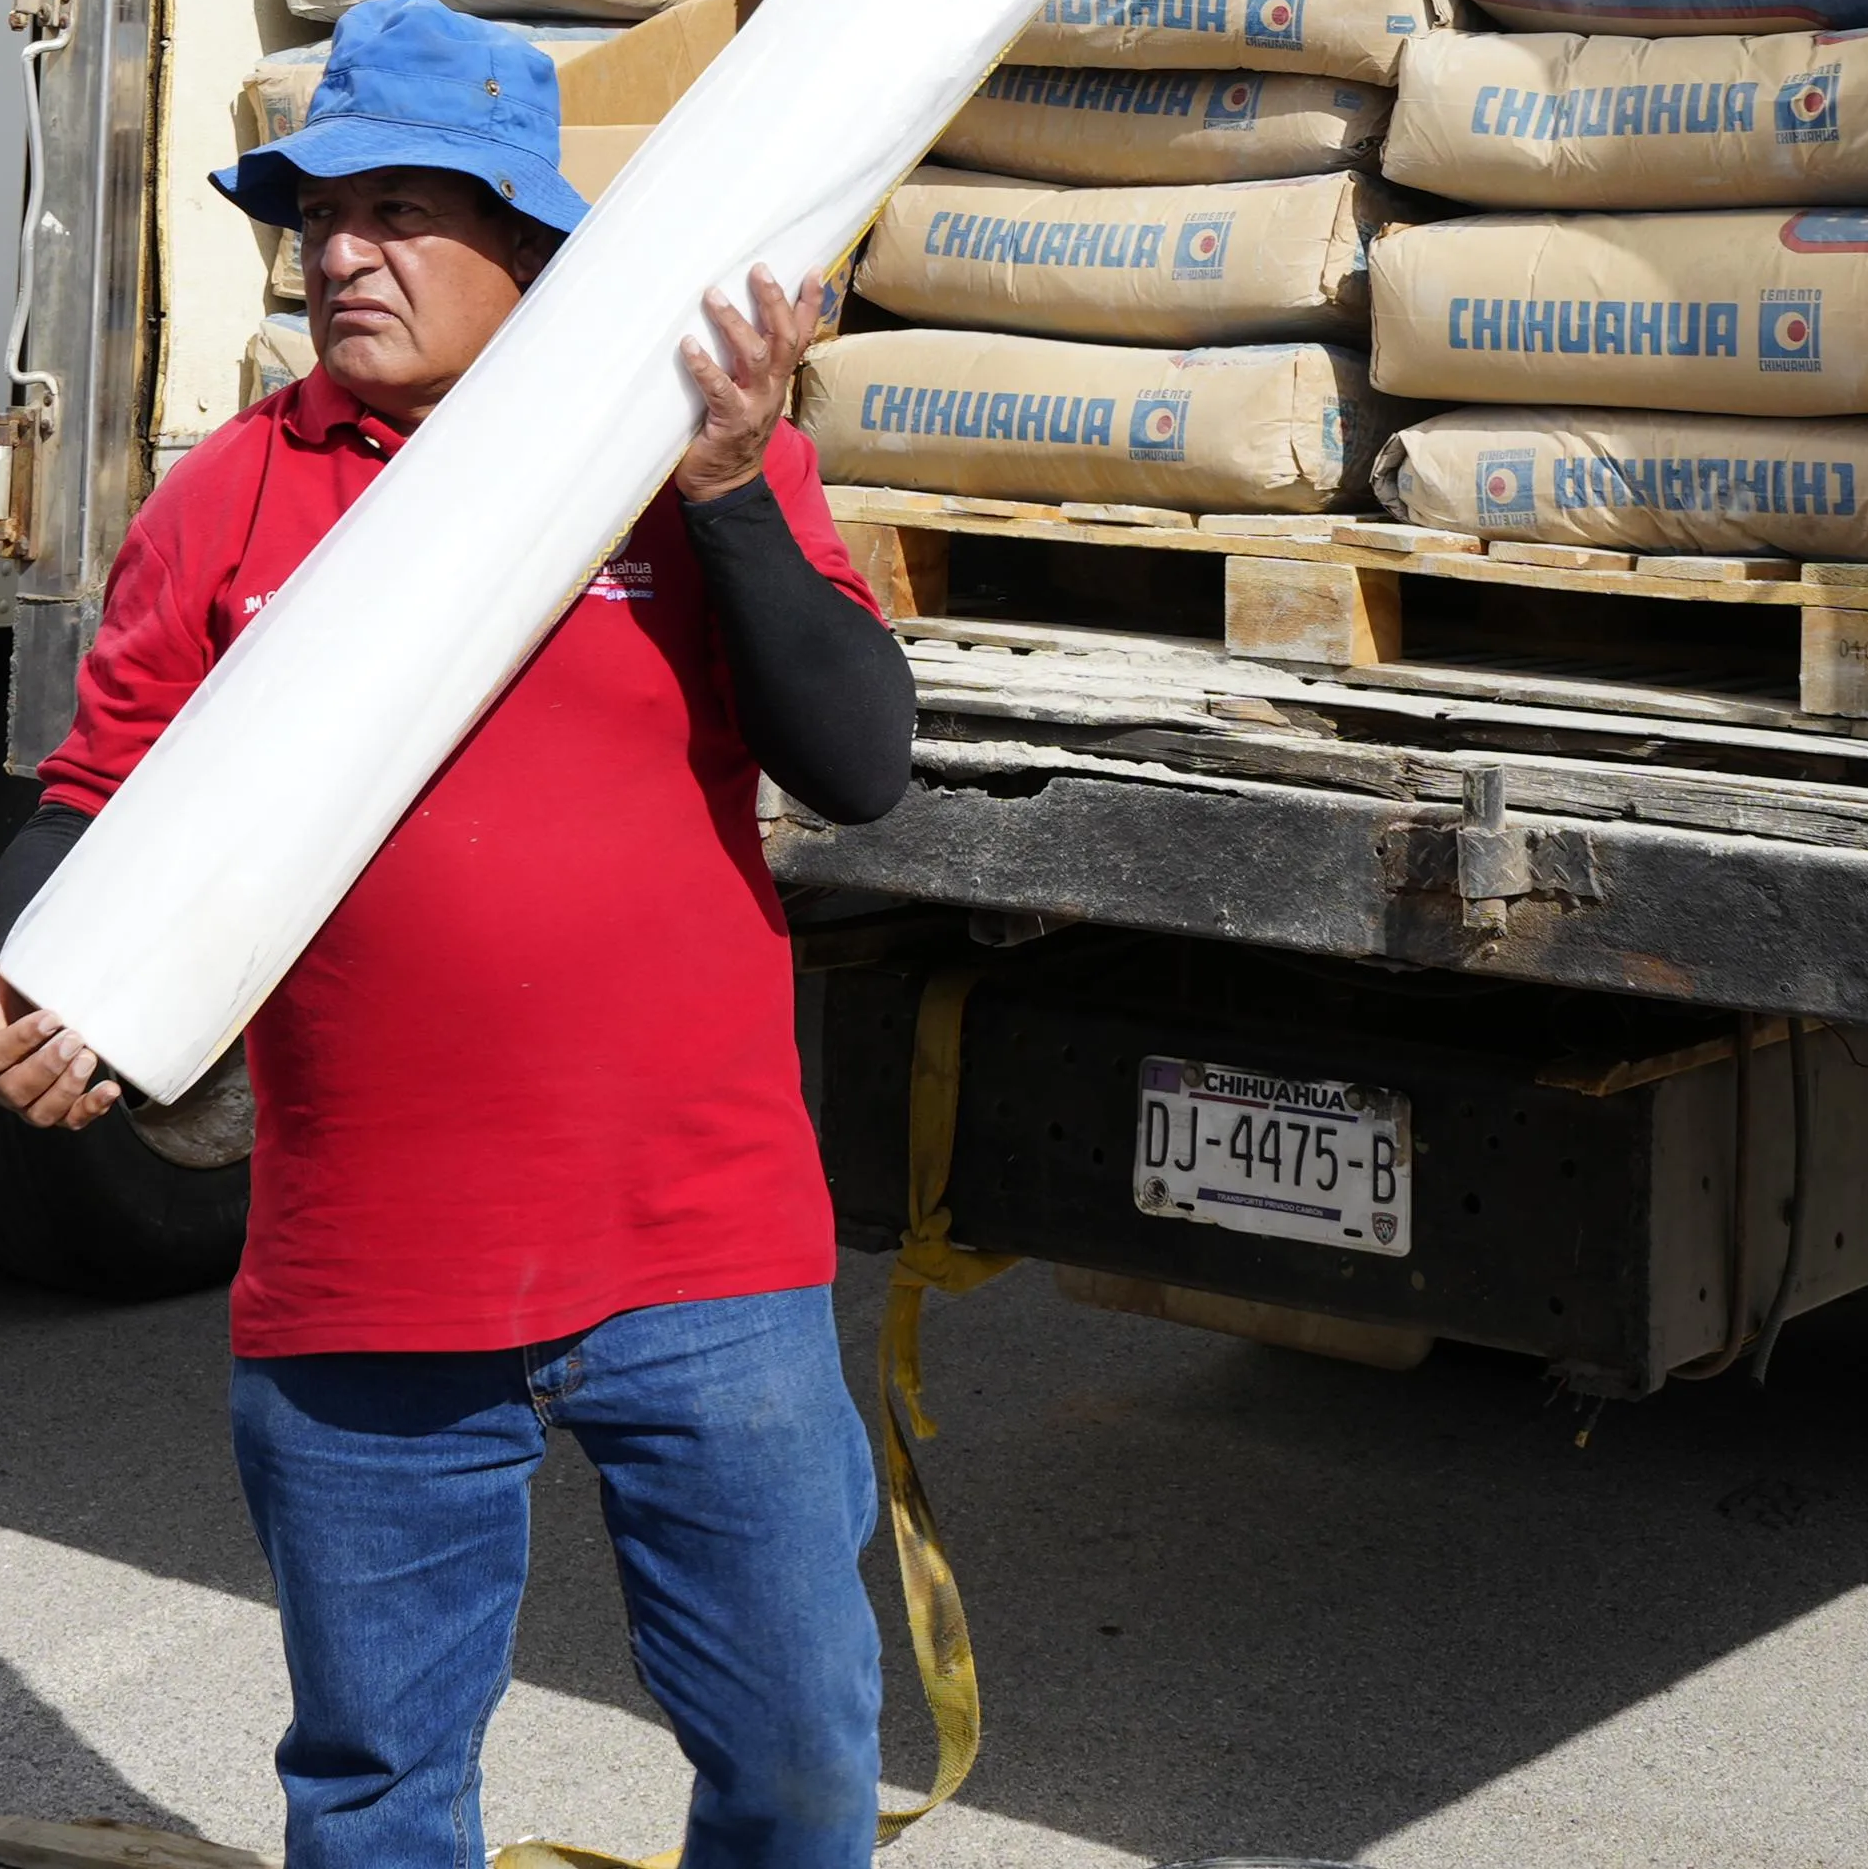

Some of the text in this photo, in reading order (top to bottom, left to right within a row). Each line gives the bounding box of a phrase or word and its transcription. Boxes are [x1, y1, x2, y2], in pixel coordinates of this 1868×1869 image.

[1471, 82, 1758, 140] CHIHUAHUA
[924, 211, 1166, 268] CHIHUAHUA
[1760, 289, 1822, 301] CEMENTO
[1449, 298, 1738, 357] CHIHUAHUA
[1759, 359, 1822, 372] CHIHUAHUA
[861, 384, 1115, 446] CHIHUAHUA
[1554, 457, 1855, 516] CHIHUAHUA
[242, 594, 263, 614] JM
[1203, 1071, 1346, 1112] CHIHUAHUA
[1145, 1100, 1397, 1205] DJ-4475-B
